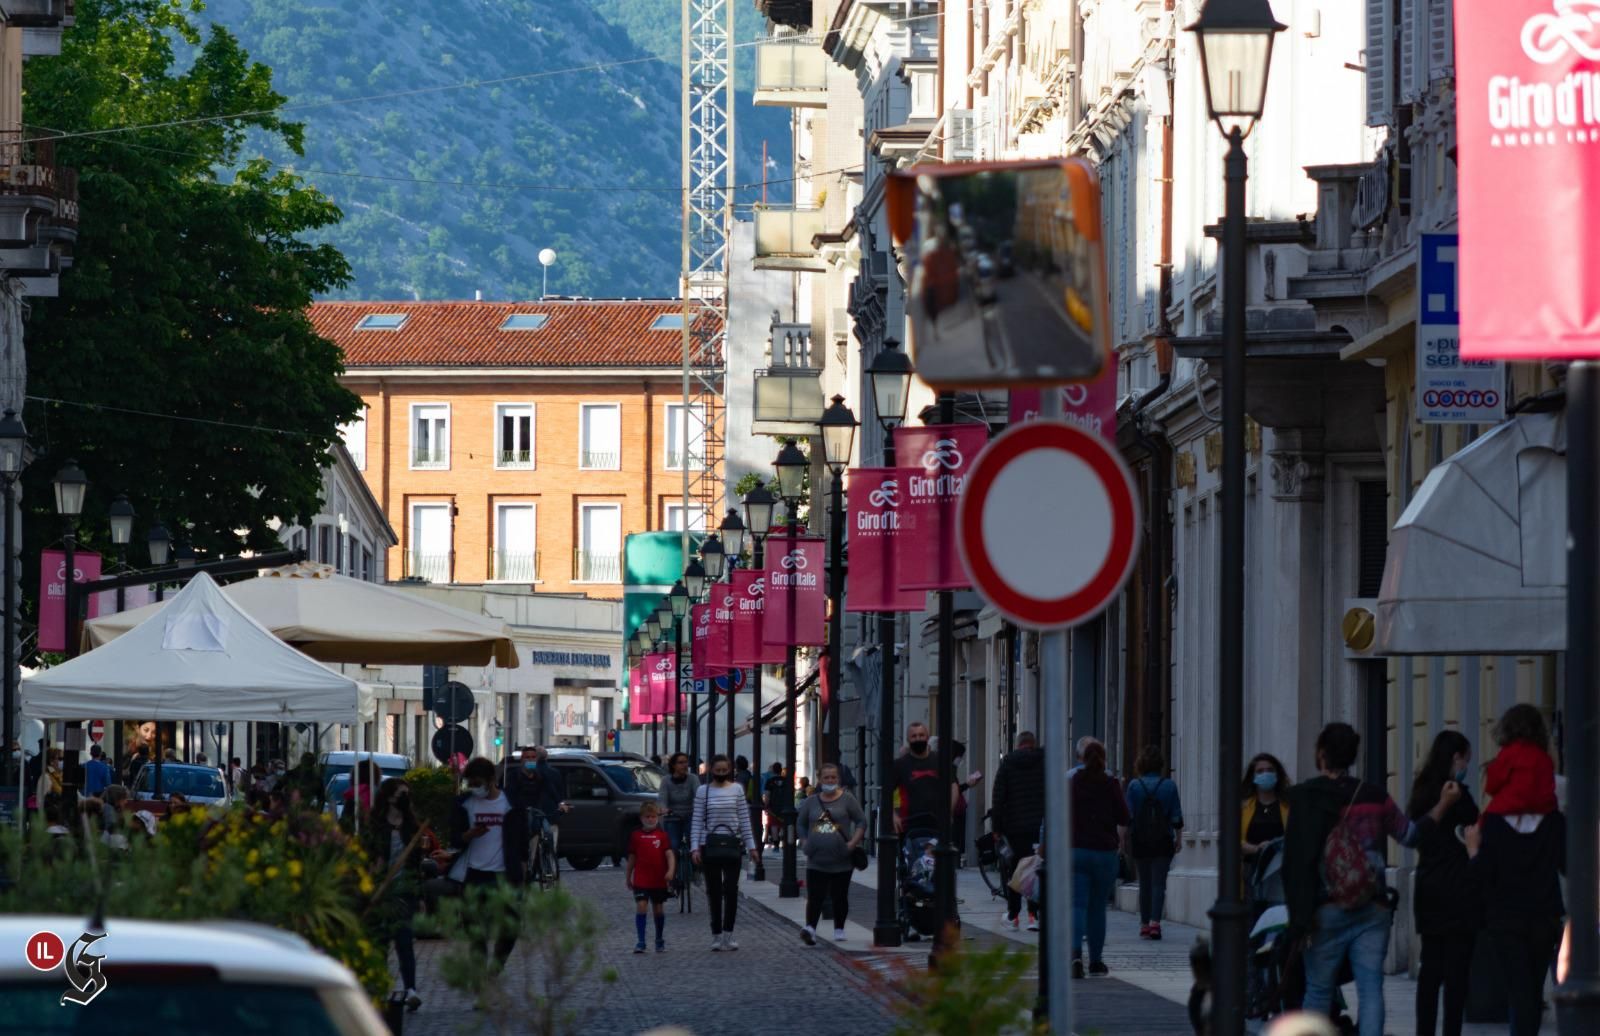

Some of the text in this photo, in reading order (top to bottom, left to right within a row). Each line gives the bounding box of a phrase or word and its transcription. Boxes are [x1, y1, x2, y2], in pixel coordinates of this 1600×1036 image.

[1488, 75, 1552, 129] Giro
[1491, 131, 1555, 147] AMORE
[1425, 391, 1498, 406] LOTTO
[909, 475, 936, 497] Giro
[857, 510, 880, 530] Giro
[771, 571, 816, 586] Giro d'Italia
[739, 597, 755, 610] Giro
[695, 682, 703, 690] P
